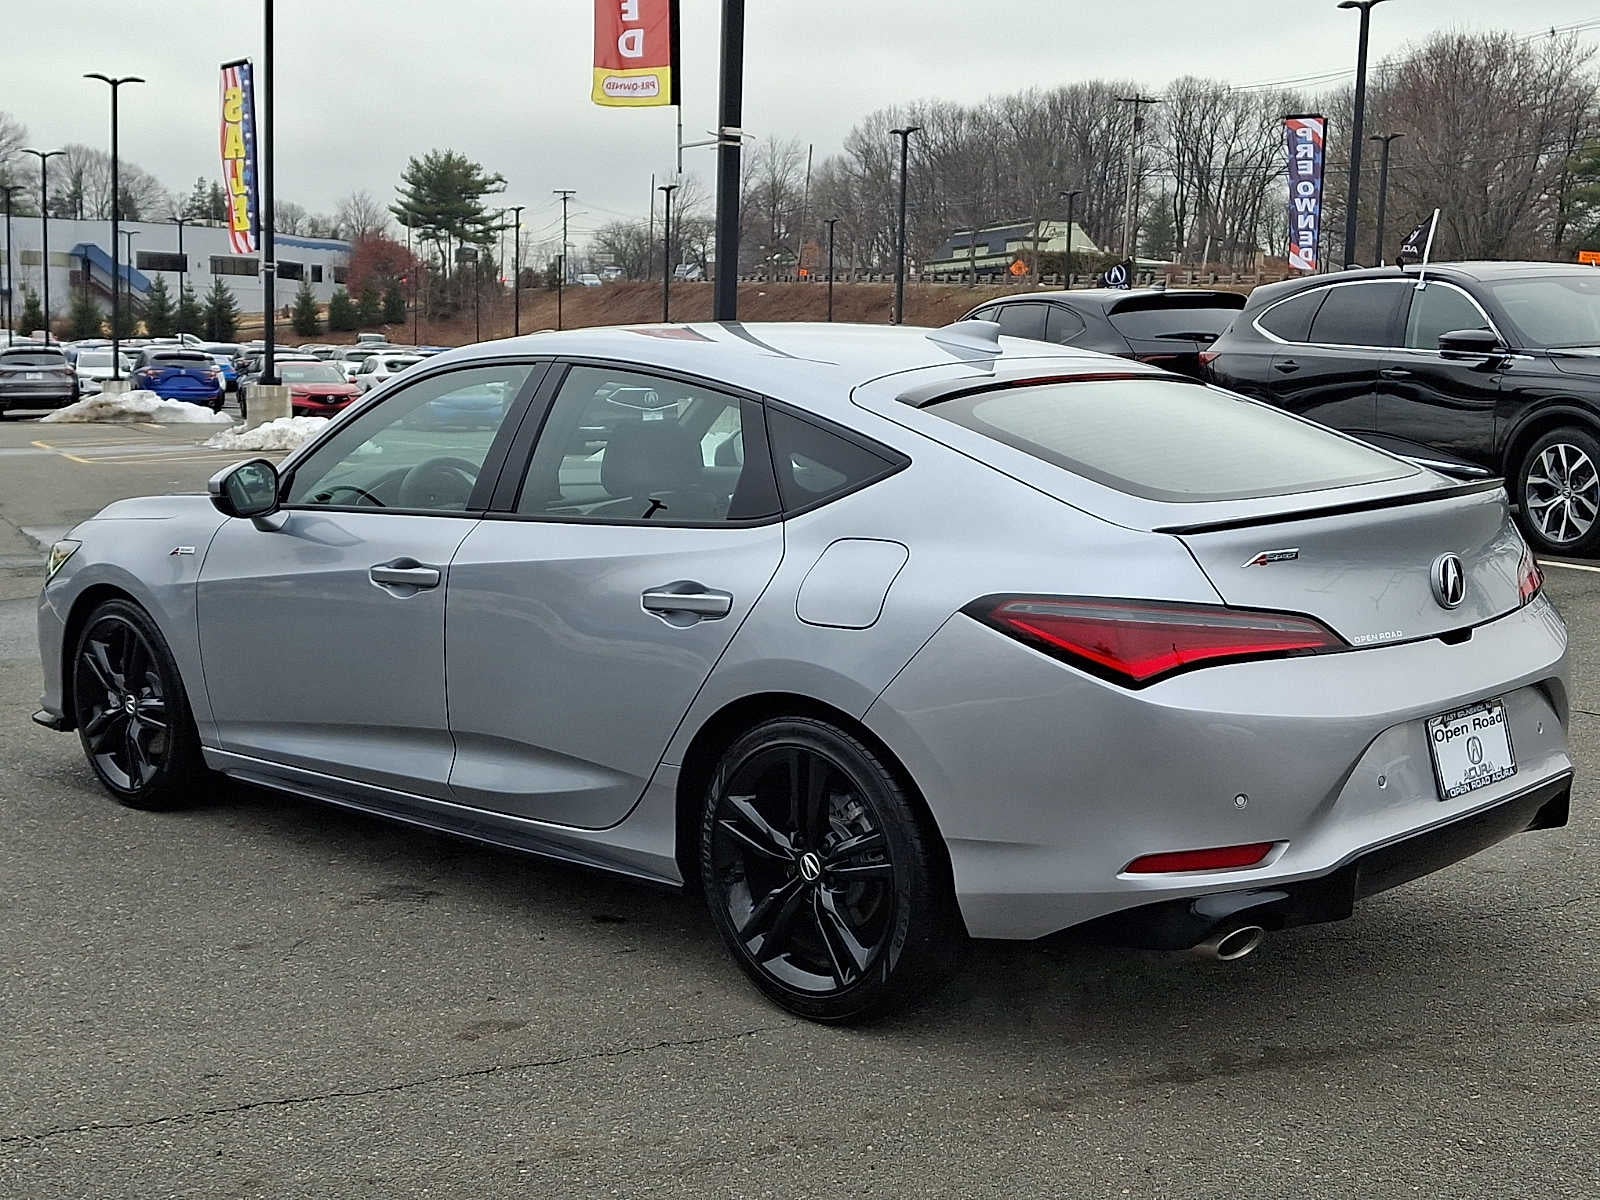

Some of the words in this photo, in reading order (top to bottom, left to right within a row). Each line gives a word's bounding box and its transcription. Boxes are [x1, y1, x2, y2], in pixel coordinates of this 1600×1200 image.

[1354, 634, 1378, 643] OPEN
[1379, 630, 1402, 640] ROAD
[1434, 724, 1468, 743] Open
[1472, 711, 1503, 731] Road
[1450, 783, 1471, 798] OPEN
[1471, 775, 1491, 790] ROAD
[1492, 767, 1515, 782] ACURA
[1464, 761, 1496, 781] ACURA
